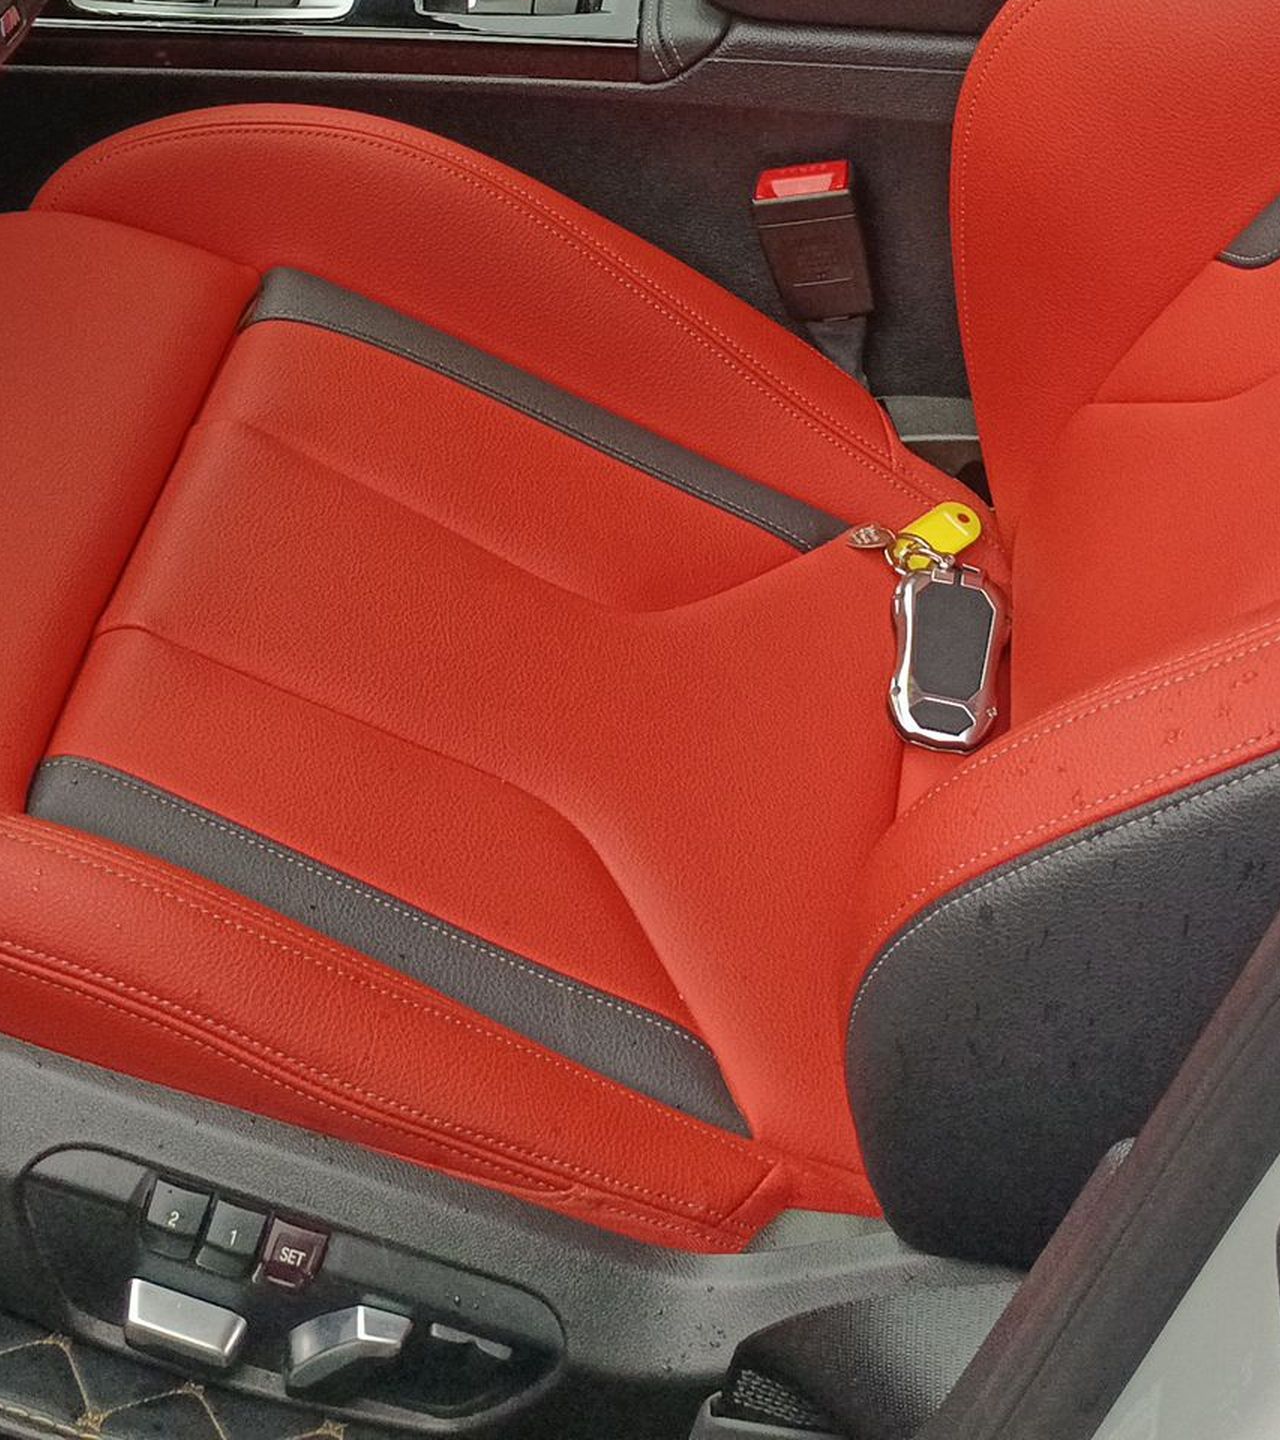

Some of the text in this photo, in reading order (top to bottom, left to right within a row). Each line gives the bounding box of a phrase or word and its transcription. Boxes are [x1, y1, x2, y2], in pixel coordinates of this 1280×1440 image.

[167, 1210, 180, 1229] 2
[230, 1229, 238, 1247] 1
[279, 1246, 307, 1268] SET
